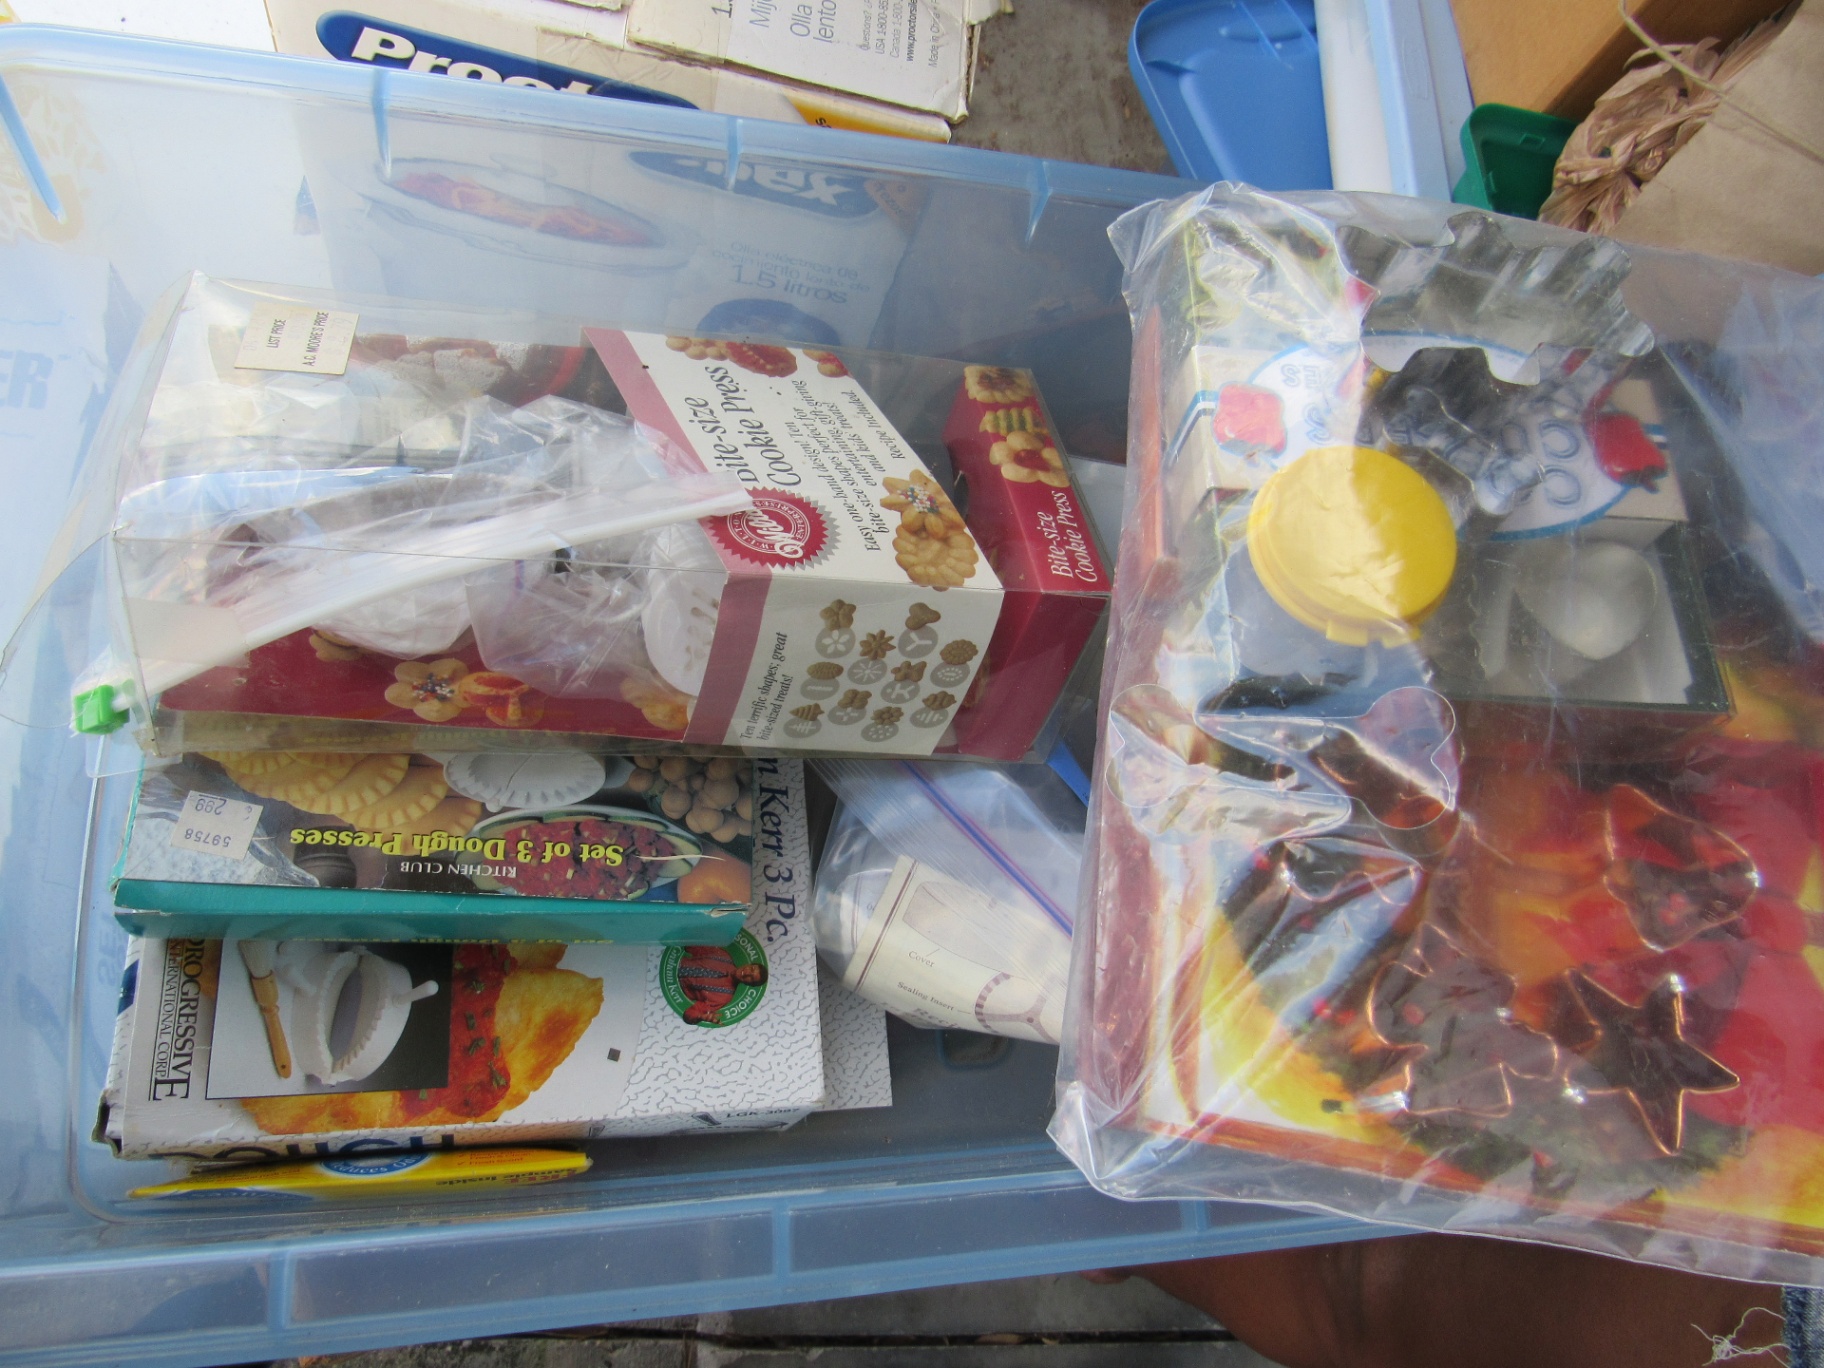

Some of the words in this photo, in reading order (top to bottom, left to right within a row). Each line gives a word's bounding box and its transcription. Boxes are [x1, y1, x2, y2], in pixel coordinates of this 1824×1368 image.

[789, 4, 813, 37] Olla
[876, 0, 889, 36] 1-800-85
[875, 38, 886, 54] USA
[890, 28, 901, 58] Canada
[928, 45, 940, 67] Made
[783, 278, 849, 305] litros
[270, 318, 287, 335] PRICE
[313, 311, 330, 327] PRICE
[266, 335, 282, 349] LIST
[305, 326, 325, 353] MOORE'S
[705, 366, 755, 414] Press
[791, 380, 836, 425] gift-giving
[793, 407, 816, 422] for
[822, 400, 853, 429] treats!
[841, 389, 881, 428] Included.
[784, 421, 804, 438] Ten
[803, 423, 840, 454] perfect
[737, 418, 802, 487] Cookie
[794, 440, 829, 472] design!
[828, 427, 877, 487] entertaining,
[876, 430, 906, 459] Recipe
[828, 455, 858, 486] shapes
[860, 454, 886, 472] and
[818, 474, 864, 523] one-hand
[853, 489, 889, 534] bite-size
[1051, 490, 1078, 528] Press
[857, 524, 881, 551] Easy
[1036, 511, 1074, 578] Bite-size
[1064, 529, 1098, 582] Cookie
[771, 631, 788, 662] great
[747, 696, 768, 724] terrific
[756, 702, 784, 741] bite-sized
[774, 674, 794, 702] treats!
[740, 723, 756, 739] Ten
[195, 798, 227, 815] 299
[759, 784, 789, 857] Kerr
[184, 828, 232, 848] 59758
[290, 828, 401, 856] Presses
[412, 833, 506, 861] Dough
[516, 841, 533, 862] 3
[542, 841, 572, 864] of
[579, 843, 624, 867] Set
[400, 861, 443, 875] CLUB
[448, 863, 518, 878] KITCHEN
[763, 864, 793, 883] 3
[765, 892, 796, 943] Pc.
[908, 950, 935, 968] Cover
[668, 984, 685, 1004] Kerr
[724, 988, 757, 1019] CHOICE
[897, 981, 929, 1001] Sealing
[930, 996, 955, 1011] Insert
[155, 1042, 170, 1078] CORP
